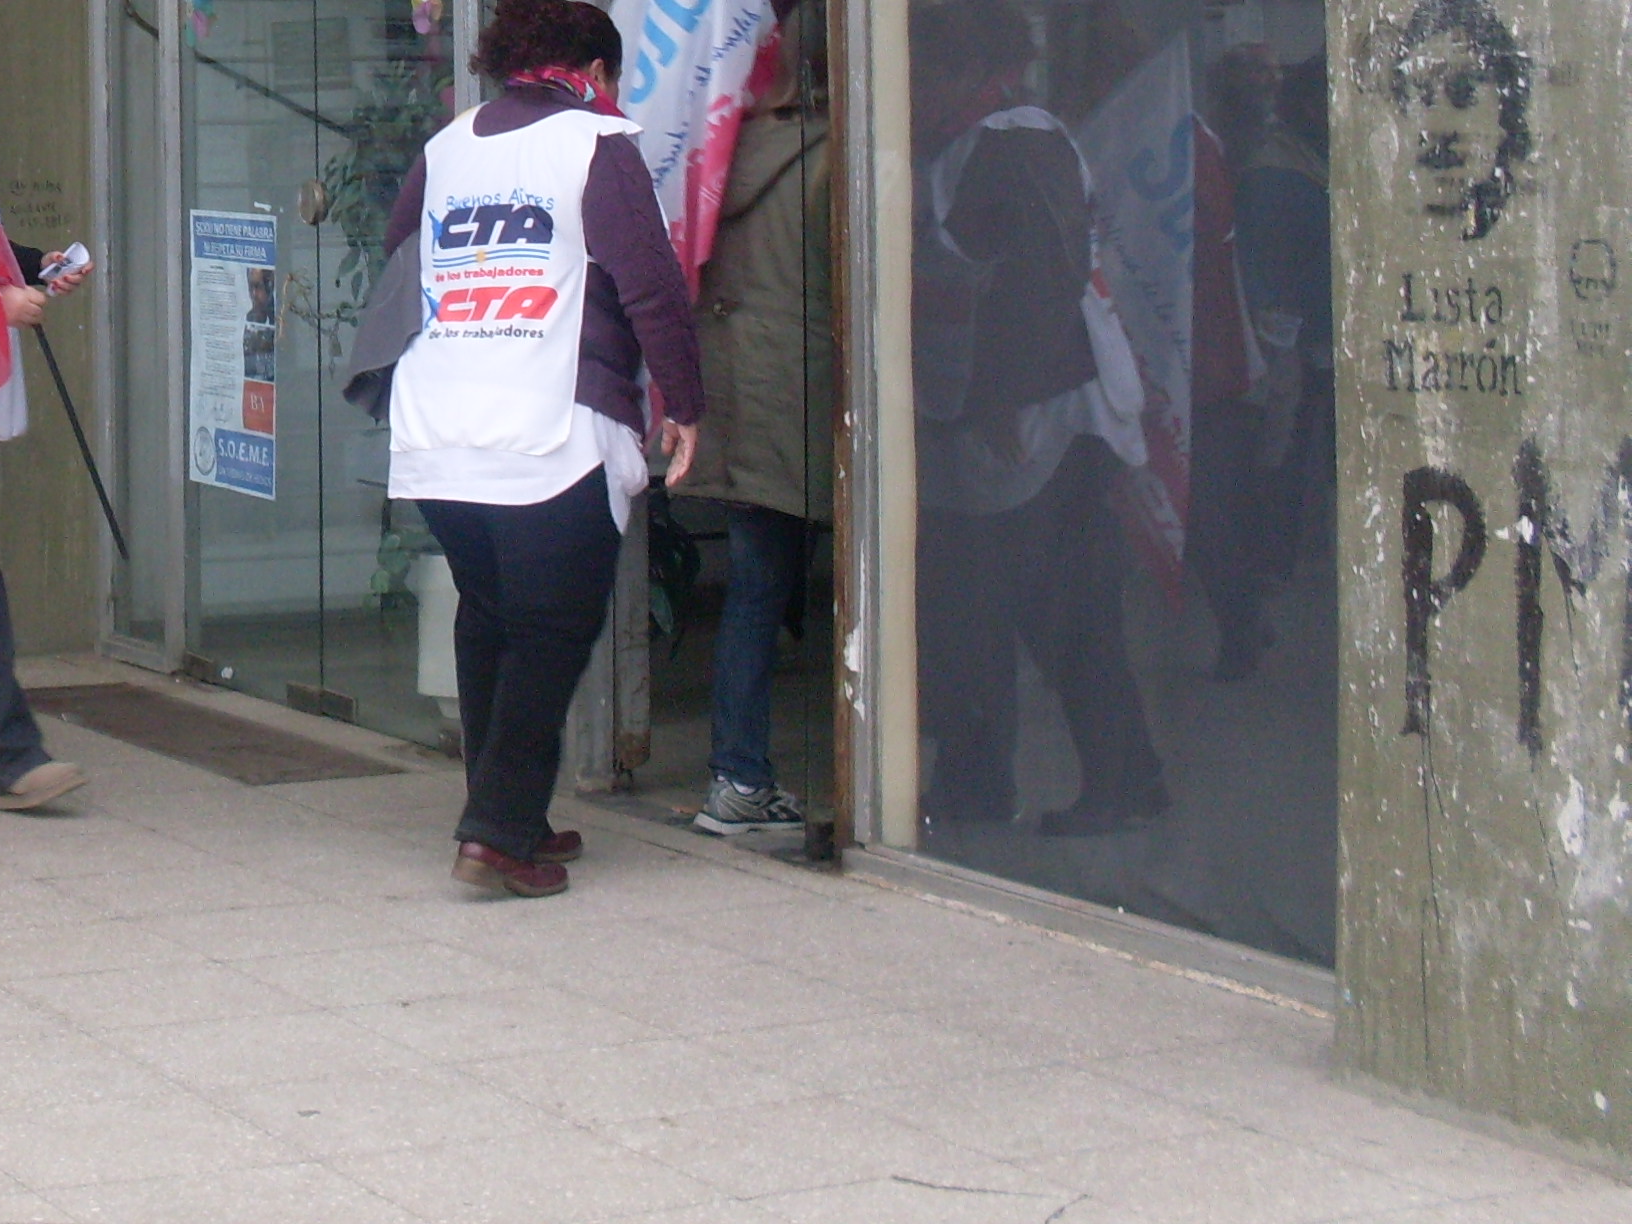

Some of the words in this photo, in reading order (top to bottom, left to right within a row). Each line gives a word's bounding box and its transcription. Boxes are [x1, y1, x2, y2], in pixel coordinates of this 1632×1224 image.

[446, 193, 502, 210] Buenos
[508, 188, 555, 210] Aires
[439, 203, 554, 249] CTA
[464, 266, 544, 279] trabajadores
[437, 286, 558, 323] CTA
[1400, 272, 1504, 323] Lista
[462, 327, 544, 339] trabajadores
[1383, 337, 1522, 396] Marrón
